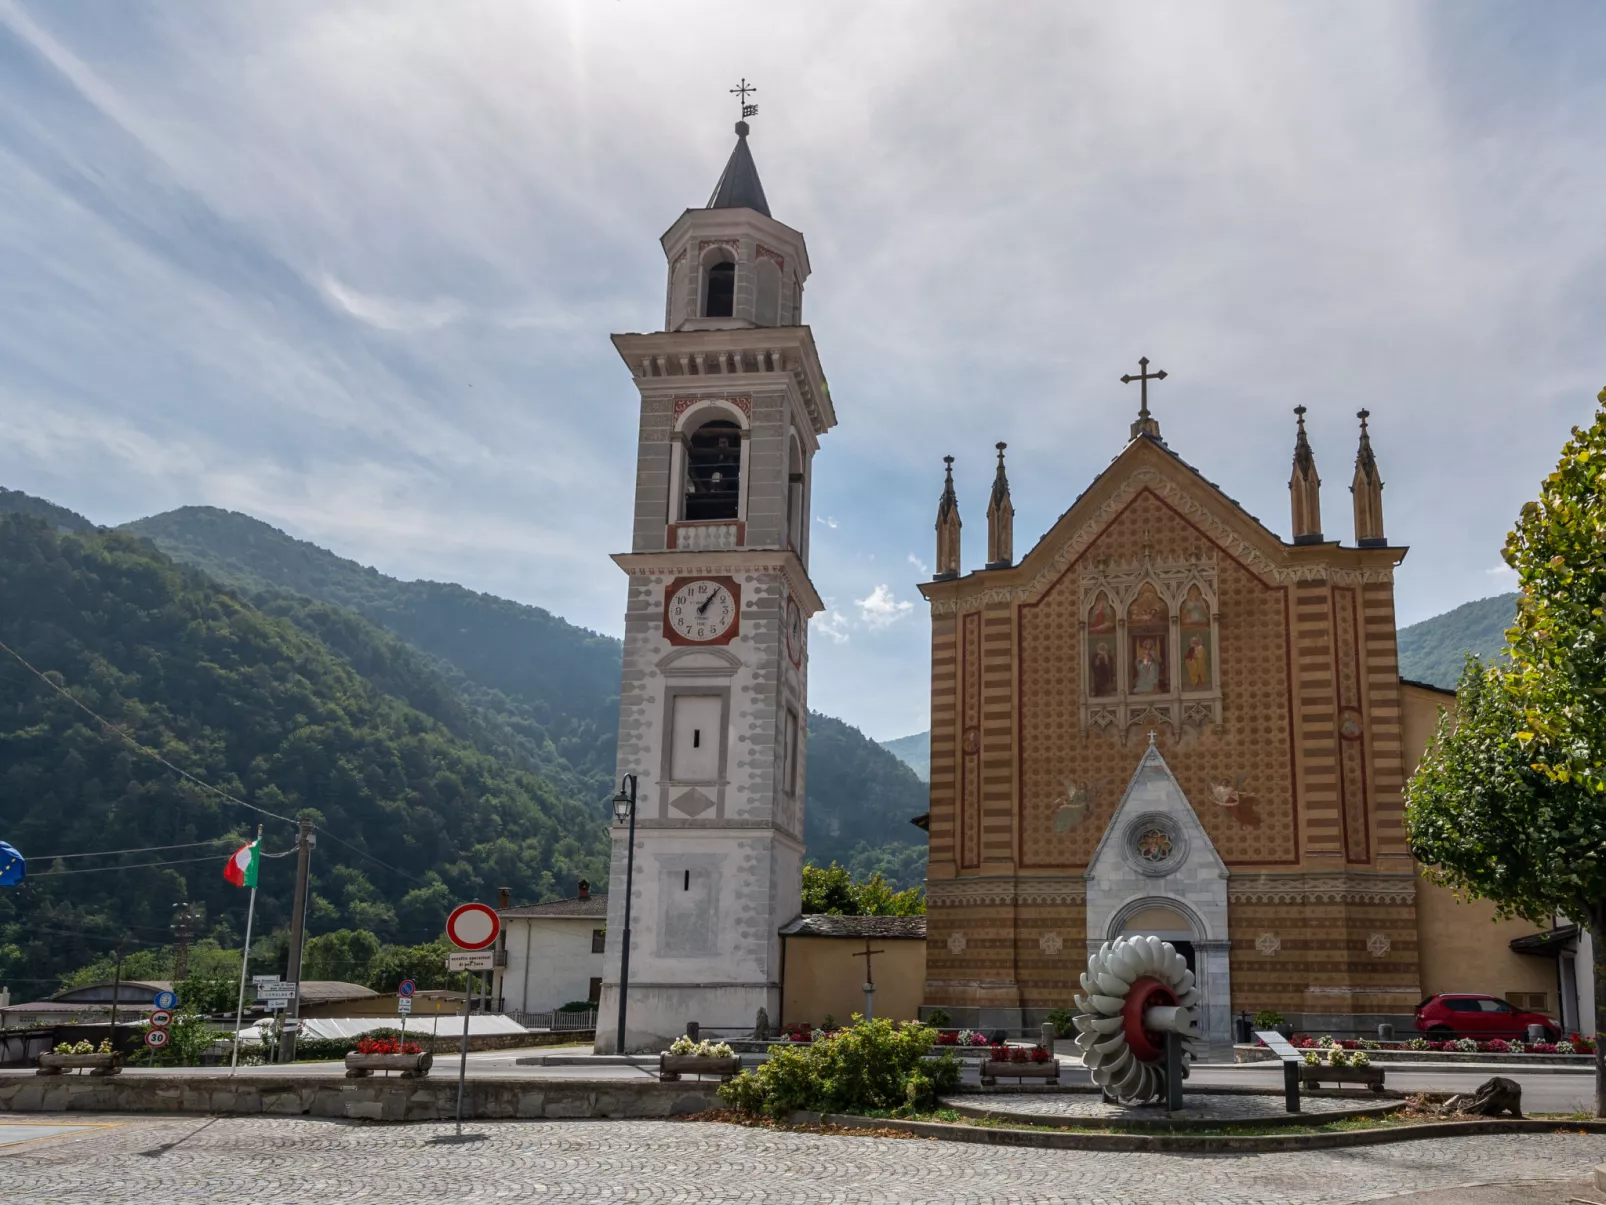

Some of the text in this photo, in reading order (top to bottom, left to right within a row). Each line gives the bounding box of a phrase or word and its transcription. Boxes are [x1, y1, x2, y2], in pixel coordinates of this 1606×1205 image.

[688, 587, 694, 596] 11
[698, 585, 708, 594] 12
[675, 596, 687, 605] 10
[720, 595, 727, 604] 2
[675, 607, 682, 615] 9
[722, 605, 729, 615] 3
[677, 617, 684, 627] 8
[719, 617, 725, 626] 4
[686, 625, 692, 634] 7
[697, 628, 704, 637] 6
[710, 625, 717, 634] 5
[150, 1034, 164, 1042] 30
